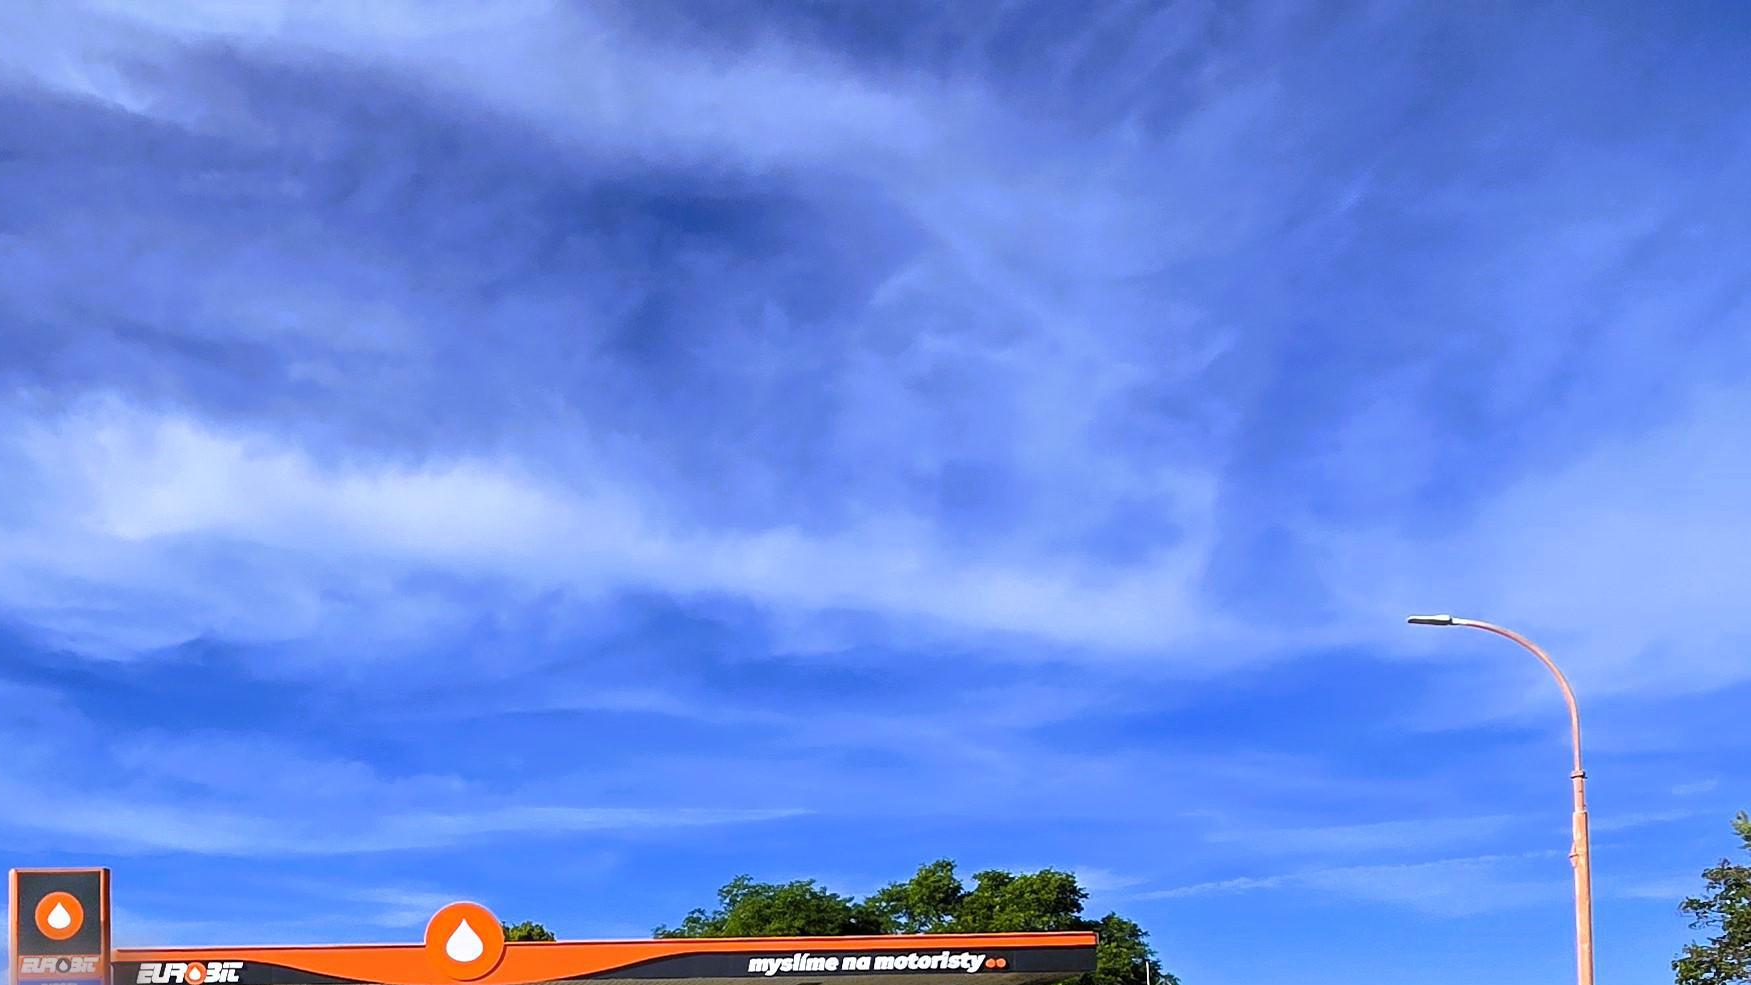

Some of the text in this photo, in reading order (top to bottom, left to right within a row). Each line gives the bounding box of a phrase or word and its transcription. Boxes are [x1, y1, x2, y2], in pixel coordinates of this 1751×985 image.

[748, 951, 985, 976] myslíme na motoristy
